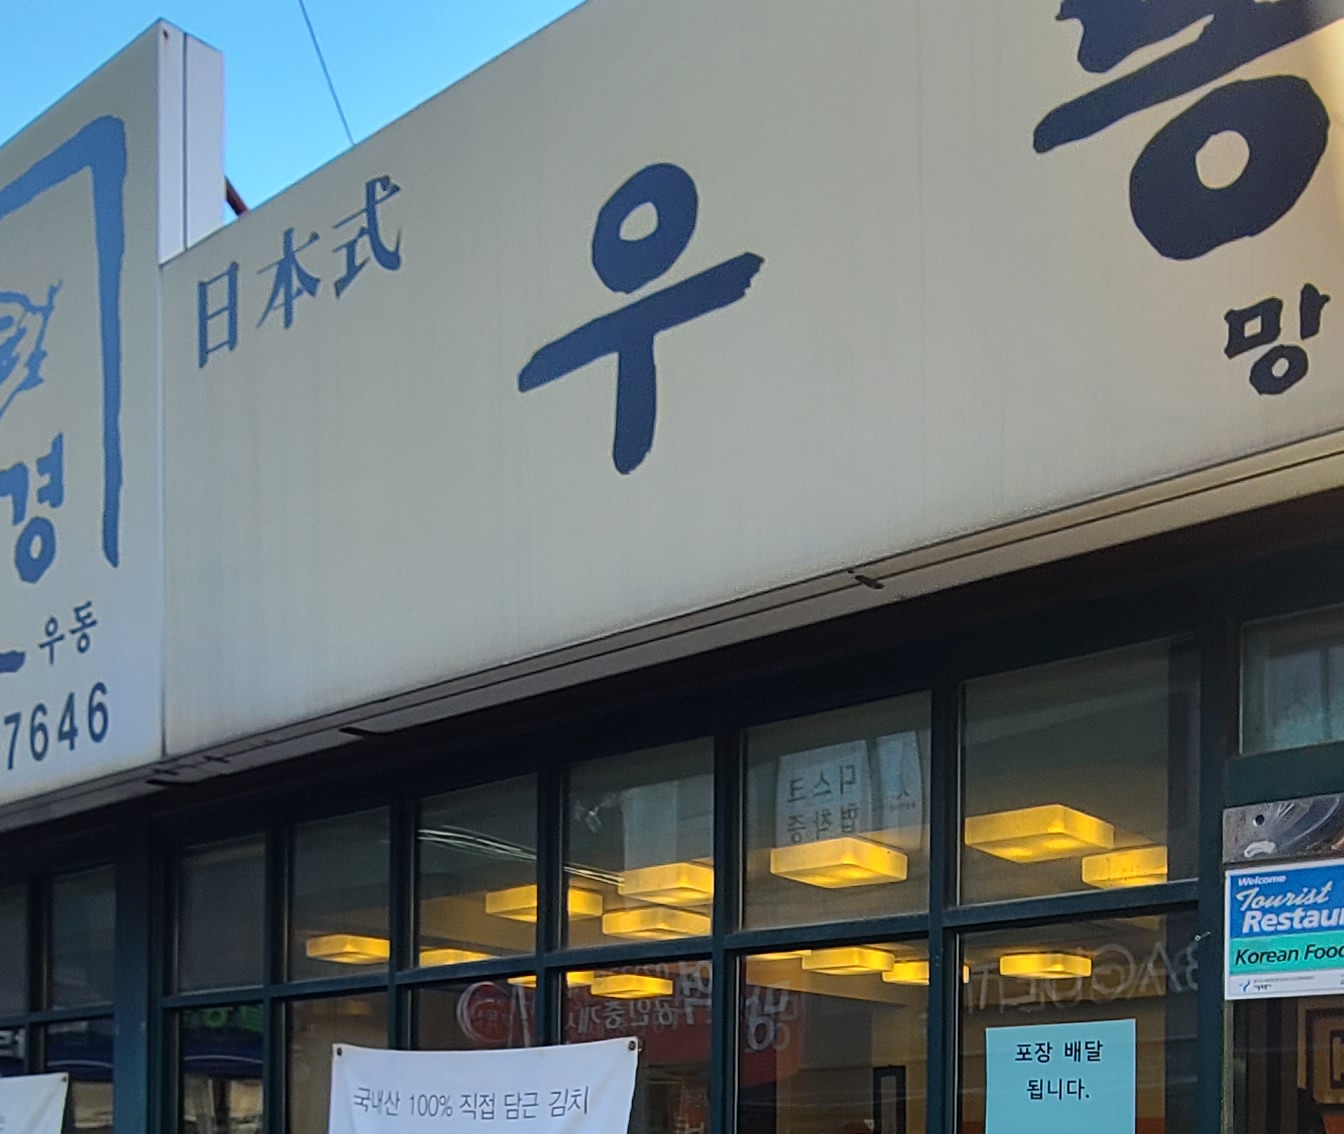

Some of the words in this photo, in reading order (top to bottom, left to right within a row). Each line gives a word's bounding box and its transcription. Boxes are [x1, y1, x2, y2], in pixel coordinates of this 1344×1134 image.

[196, 175, 402, 369] 日本式
[38, 600, 99, 666] 우동
[1238, 874, 1287, 887] Welcome
[1235, 880, 1333, 911] Tourist
[1235, 948, 1299, 966] Korean
[1015, 1041, 1053, 1063] 포장
[1064, 1040, 1103, 1063] 배달
[353, 1087, 400, 1117] 국내산
[409, 1093, 453, 1118] 100%
[459, 1092, 495, 1120] 직접
[504, 1092, 539, 1120] 담근
[548, 1086, 589, 1118] 김치
[1026, 1078, 1091, 1101] 됩니다.
